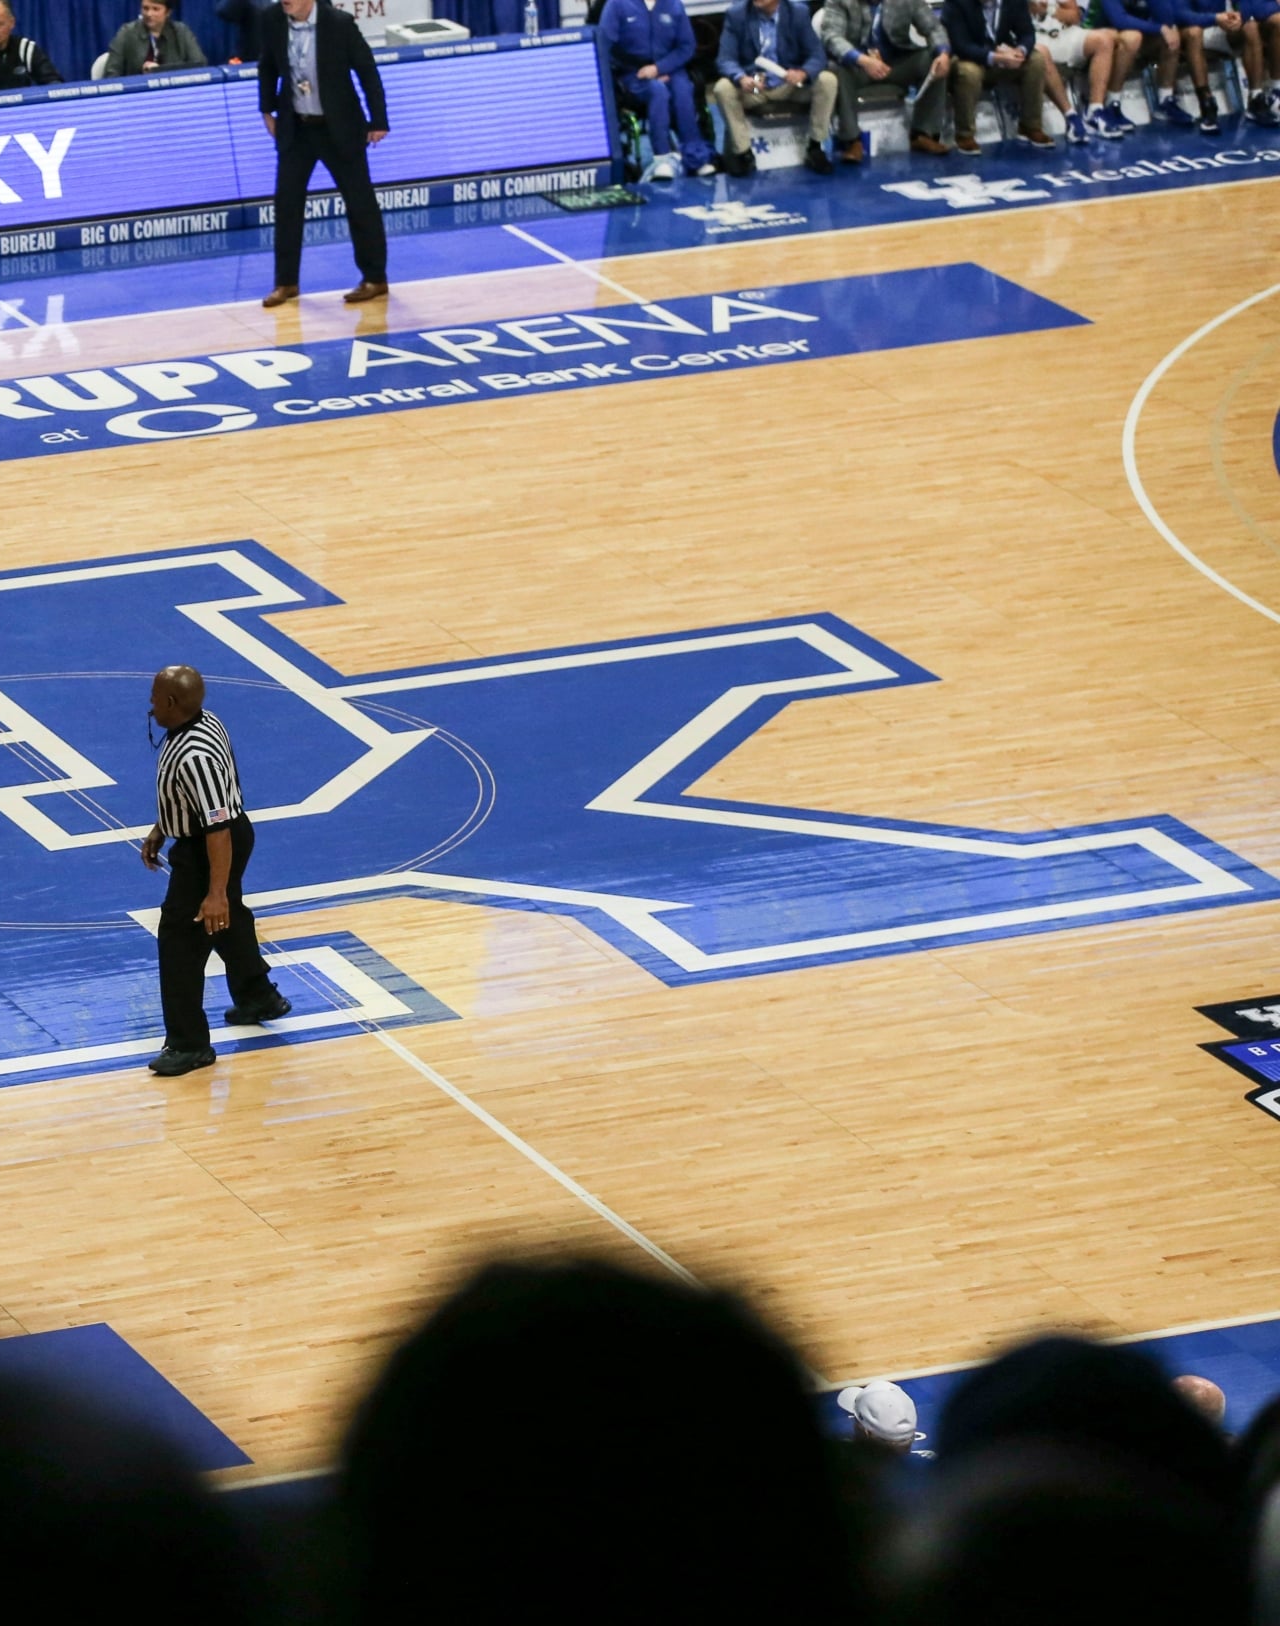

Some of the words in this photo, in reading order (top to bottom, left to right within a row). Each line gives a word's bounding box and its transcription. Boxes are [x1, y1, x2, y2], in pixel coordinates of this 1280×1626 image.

[453, 182, 477, 202] BIG
[481, 180, 501, 199] ON
[504, 168, 598, 197] COMMITMENT
[259, 198, 330, 225] KECKY
[375, 187, 430, 210] BUREAU
[0, 231, 56, 255] BUREAU
[81, 226, 105, 247] BIG
[109, 222, 130, 242] ON
[134, 210, 228, 240] COMMITMENT
[40, 427, 88, 443] at
[273, 379, 478, 415] Central
[478, 361, 634, 391] Bank
[631, 335, 810, 372] Center
